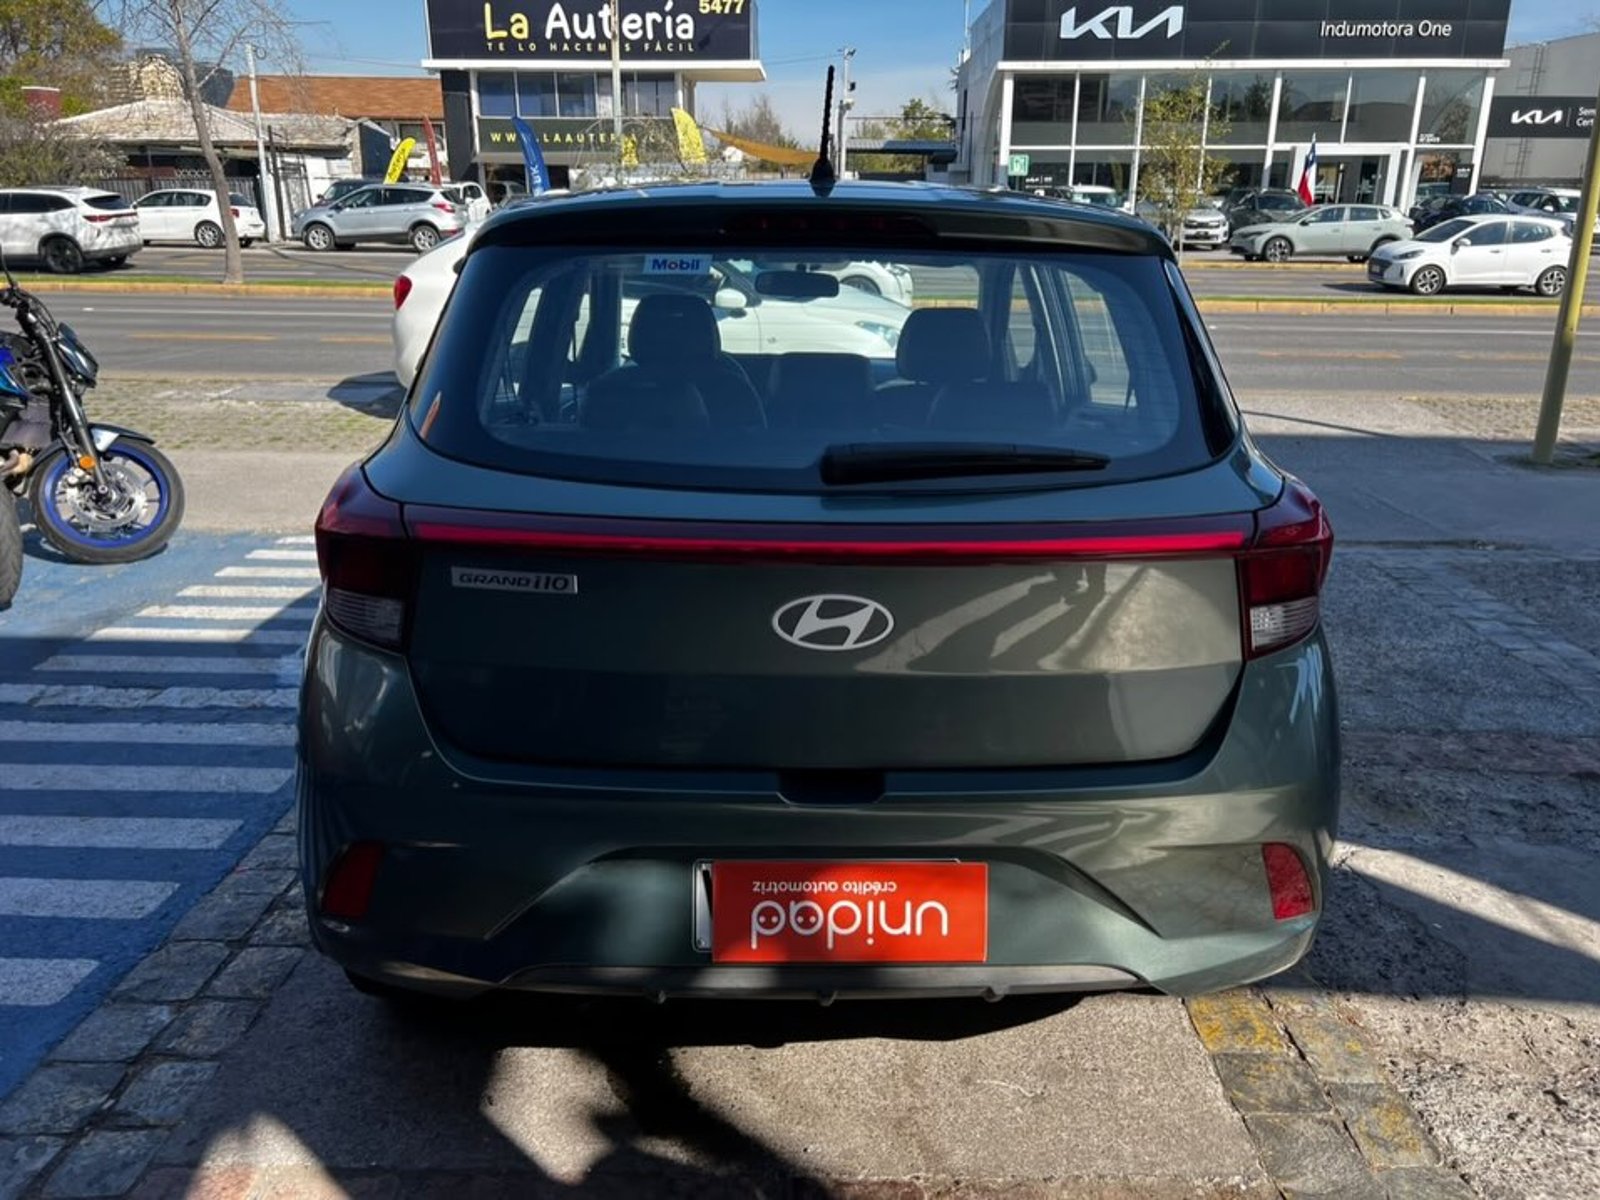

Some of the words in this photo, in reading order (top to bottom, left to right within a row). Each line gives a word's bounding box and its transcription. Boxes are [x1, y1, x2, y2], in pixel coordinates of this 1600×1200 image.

[699, 0, 744, 14] 5477
[484, 2, 529, 40] La
[545, 0, 695, 40] Autería
[1059, 6, 1184, 39] KIA
[1320, 20, 1413, 37] Indumotora
[1417, 20, 1452, 37] One
[487, 42, 505, 51] TE
[518, 42, 537, 51] LO
[550, 42, 632, 51] HACEMS
[643, 40, 695, 51] FÁCIL
[1575, 117, 1595, 127] Cert
[651, 258, 700, 271] Mobil
[458, 572, 531, 588] GRAND
[752, 880, 839, 894] automotriz
[842, 880, 897, 894] crédito
[750, 899, 949, 951] unidad
